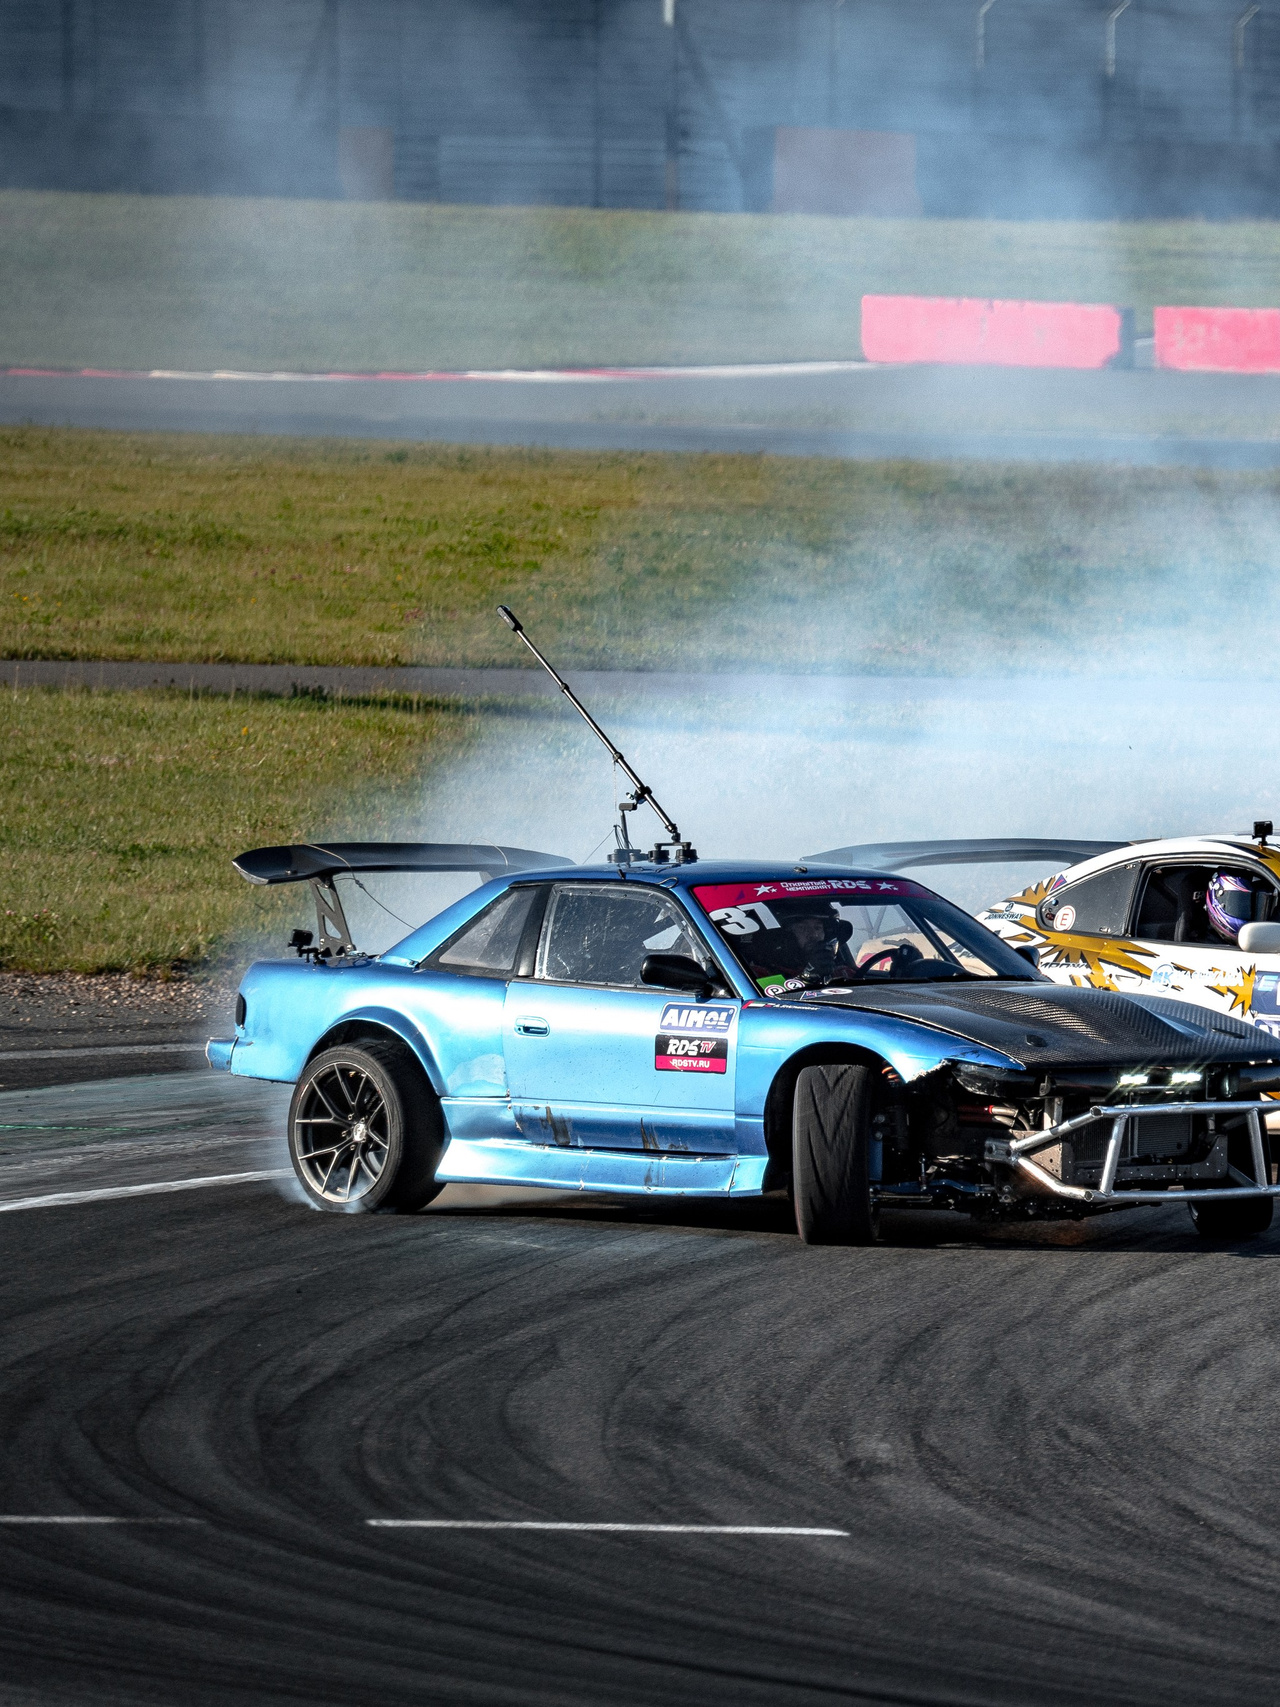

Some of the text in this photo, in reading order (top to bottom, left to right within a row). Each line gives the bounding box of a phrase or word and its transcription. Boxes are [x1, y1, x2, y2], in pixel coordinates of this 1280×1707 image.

[827, 879, 872, 890] RDS
[708, 901, 782, 936] 37
[661, 1008, 729, 1030] AIMOL
[666, 1038, 717, 1056] RDS TV
[671, 1058, 710, 1069] RDSTV.RU
